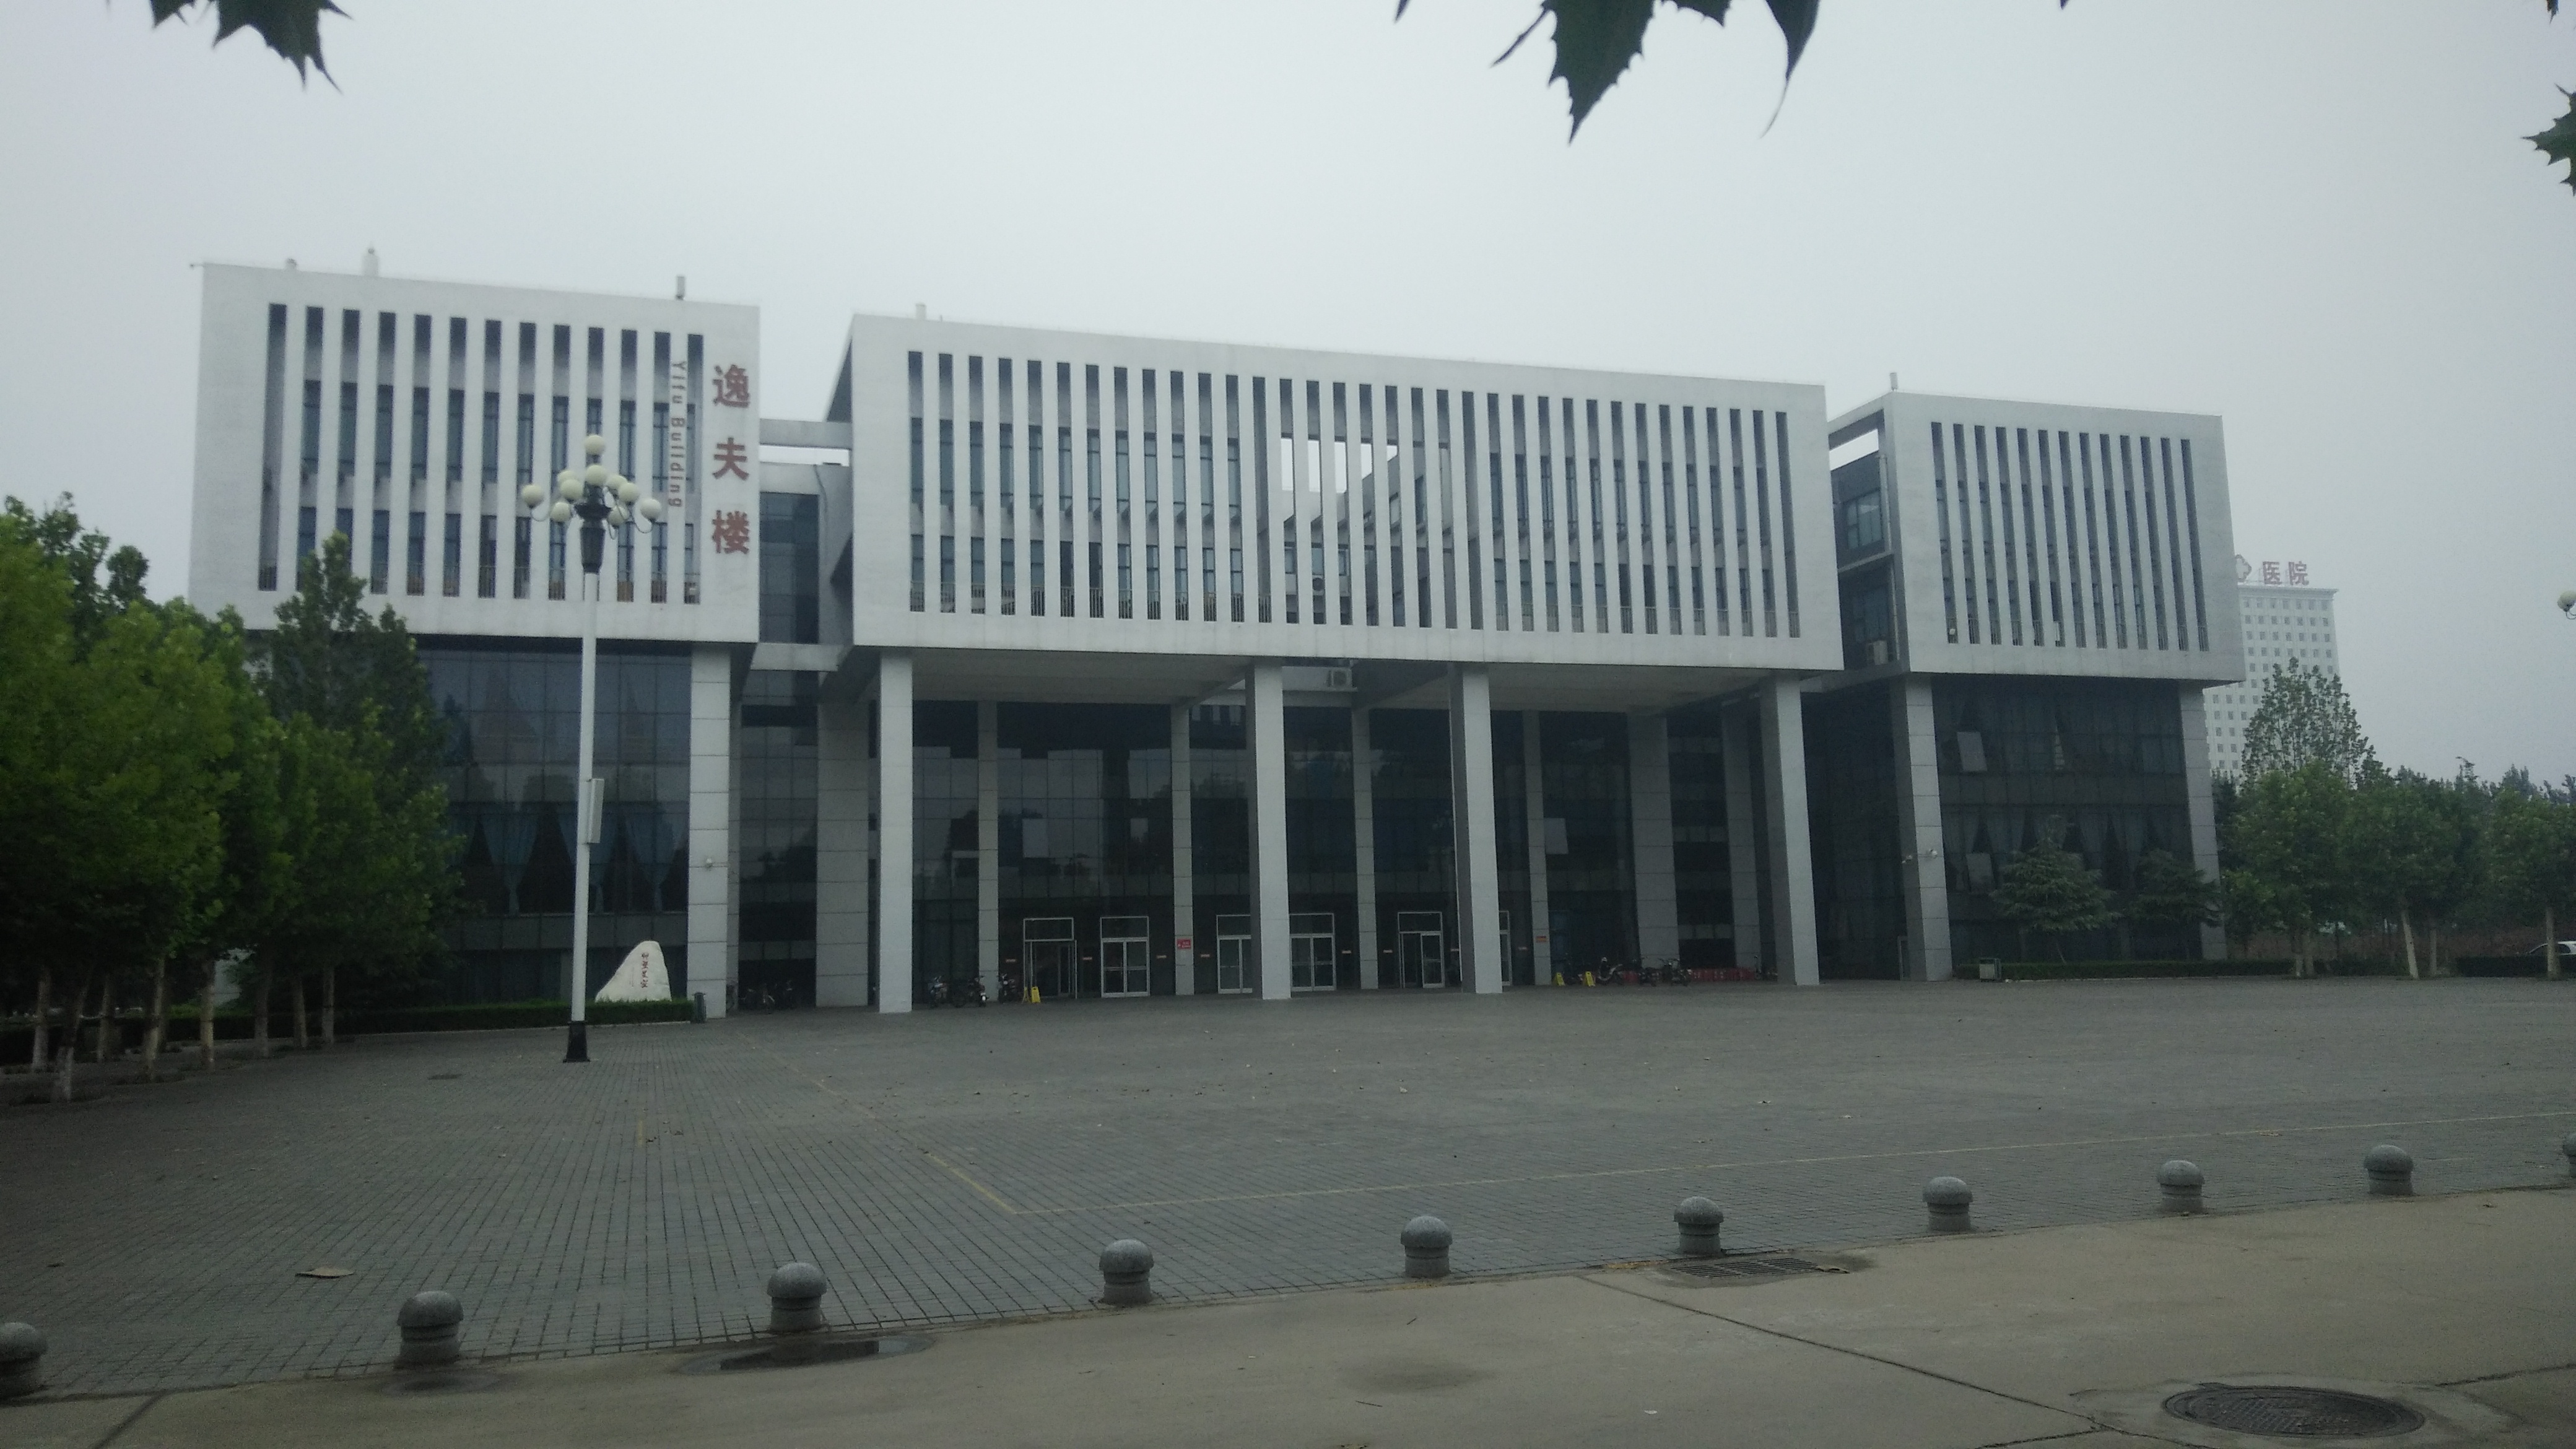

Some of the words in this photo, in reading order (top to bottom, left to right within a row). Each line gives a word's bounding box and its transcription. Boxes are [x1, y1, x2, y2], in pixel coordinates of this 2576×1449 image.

[672, 361, 687, 404] Yifu
[668, 417, 685, 508] Building
[712, 364, 750, 554] 逸夫楼
[2262, 560, 2309, 585] 医院
